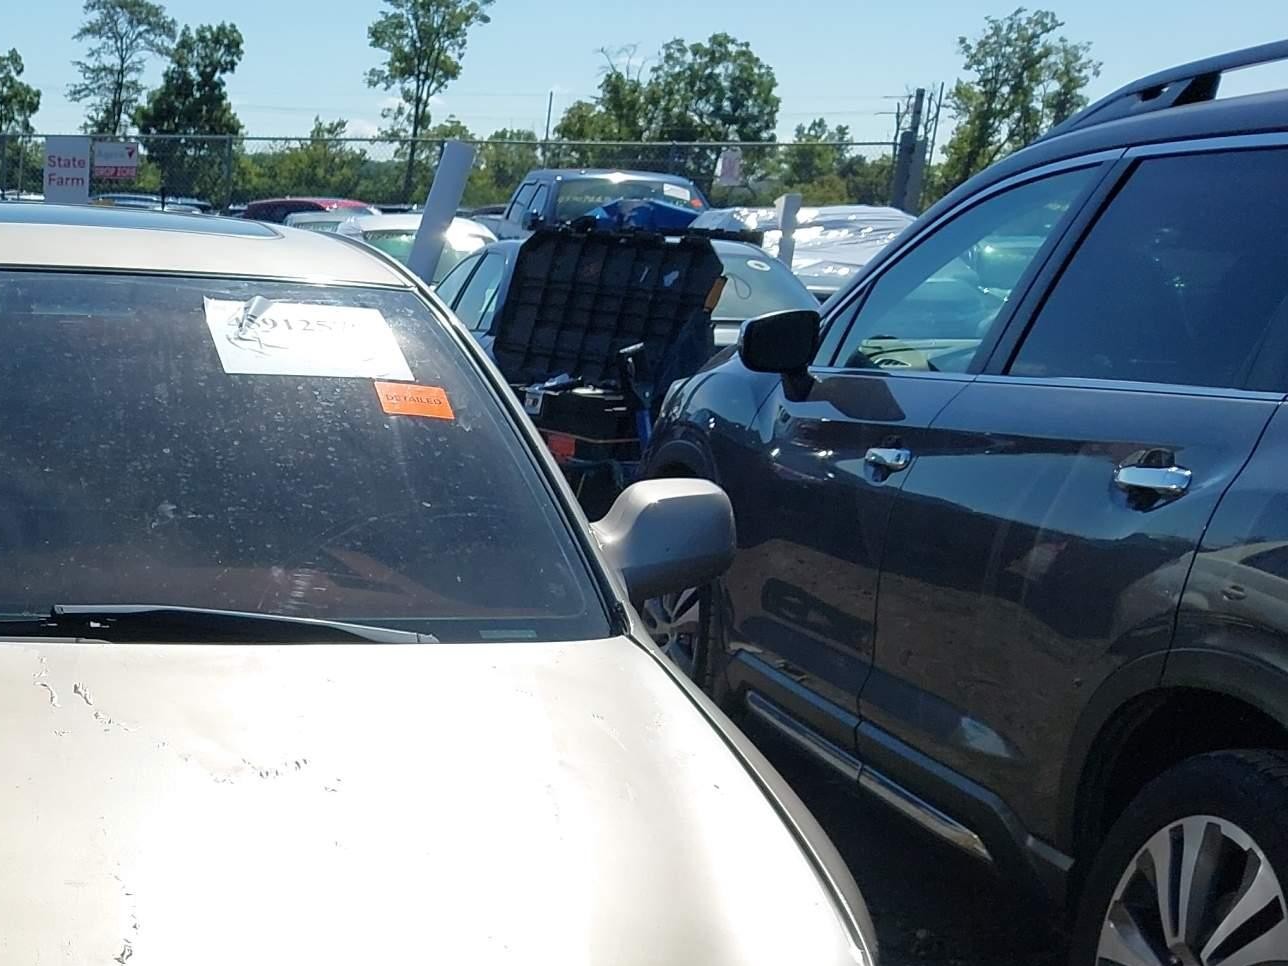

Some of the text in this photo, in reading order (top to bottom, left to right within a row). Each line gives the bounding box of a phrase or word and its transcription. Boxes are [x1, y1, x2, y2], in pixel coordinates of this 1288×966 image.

[47, 155, 86, 169] State
[47, 173, 85, 187] Farm
[385, 393, 443, 405] DETAILED
